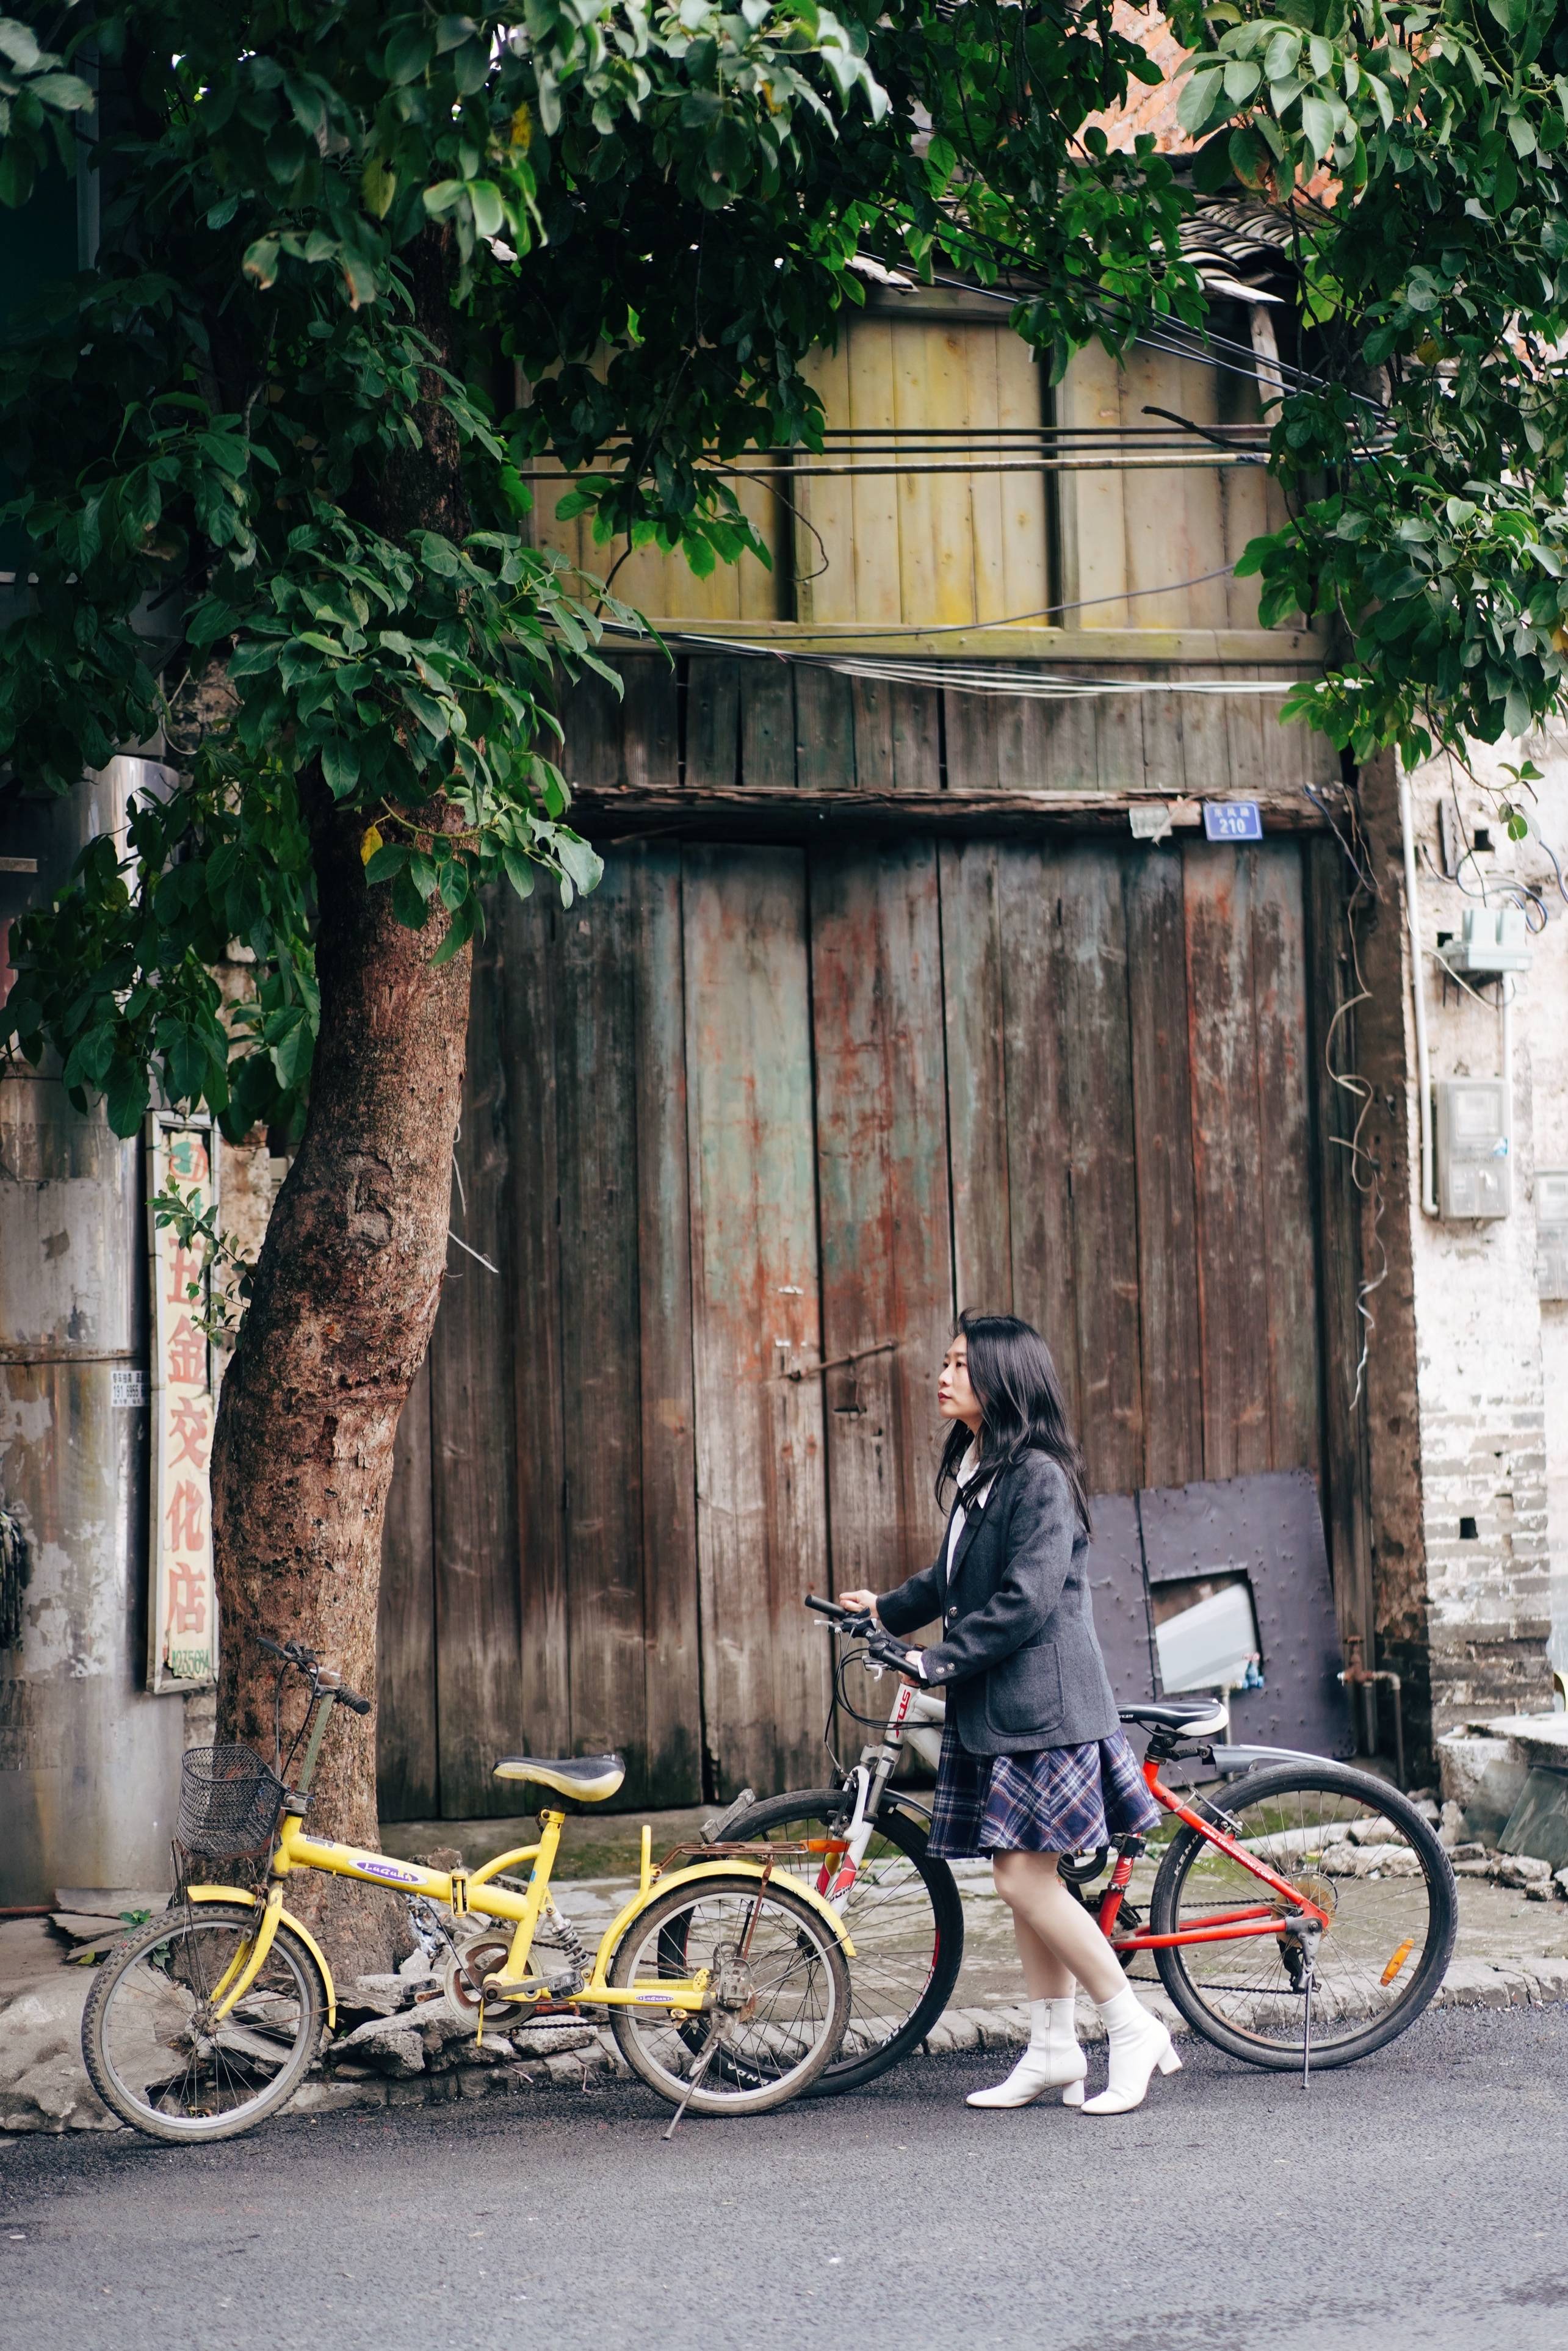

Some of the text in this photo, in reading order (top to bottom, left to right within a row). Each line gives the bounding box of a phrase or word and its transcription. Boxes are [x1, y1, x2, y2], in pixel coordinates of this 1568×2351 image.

[1219, 818, 1246, 834] 210
[166, 1237, 209, 1635] 五金交化店
[1174, 1832, 1202, 1876] KEND
[727, 2062, 771, 2086] ENDA
